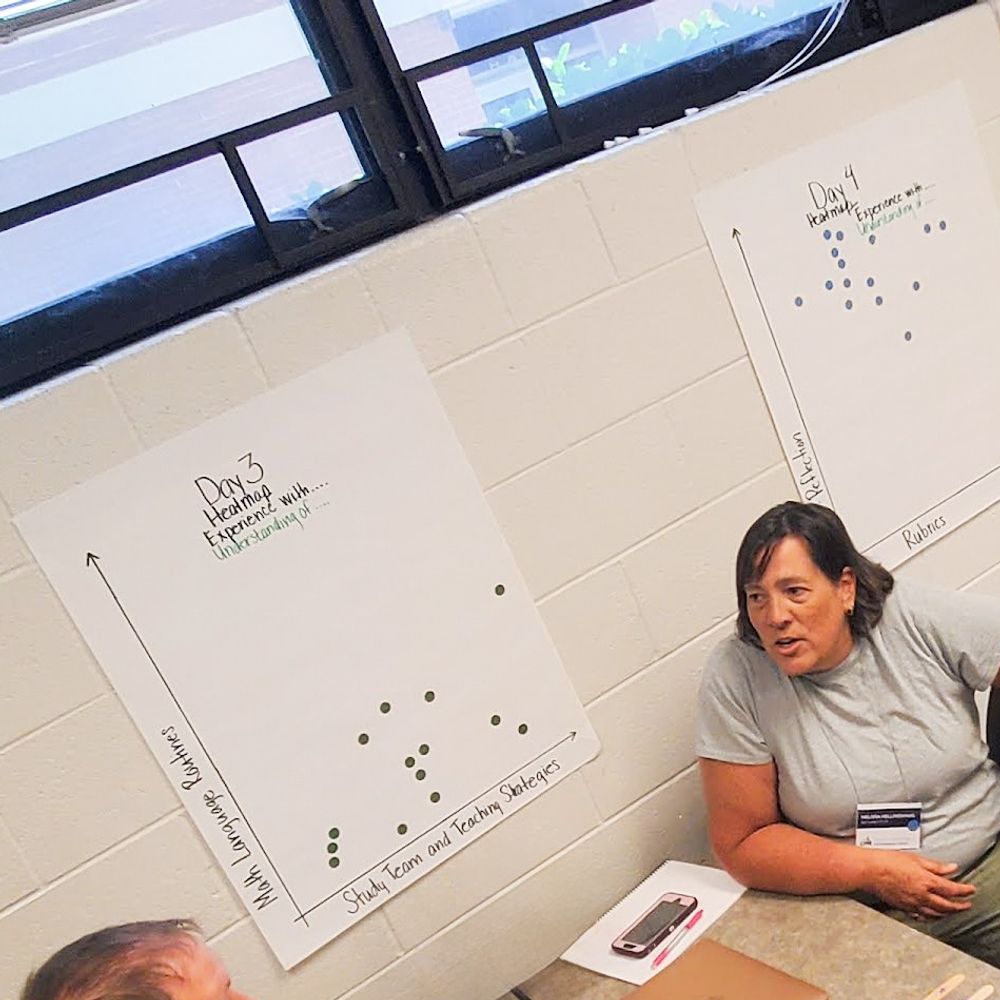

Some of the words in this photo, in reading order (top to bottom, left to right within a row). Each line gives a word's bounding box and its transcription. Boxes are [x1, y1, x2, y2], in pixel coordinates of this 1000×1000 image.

[808, 181, 849, 211] Day
[844, 163, 859, 190] 4
[855, 192, 902, 222] Experience
[194, 474, 247, 506] Day
[238, 452, 264, 484] 3
[792, 431, 823, 501] Reflection
[203, 484, 272, 527] Heatmap
[203, 502, 277, 551] Experience
[212, 517, 304, 560] Understanding
[902, 515, 947, 550] Rubrics
[161, 725, 203, 791] Routines
[203, 789, 251, 867] Language
[342, 878, 391, 914] Study
[381, 853, 424, 881] Team
[427, 830, 453, 857] and
[449, 801, 504, 836] Teaching
[244, 863, 278, 911] Math
